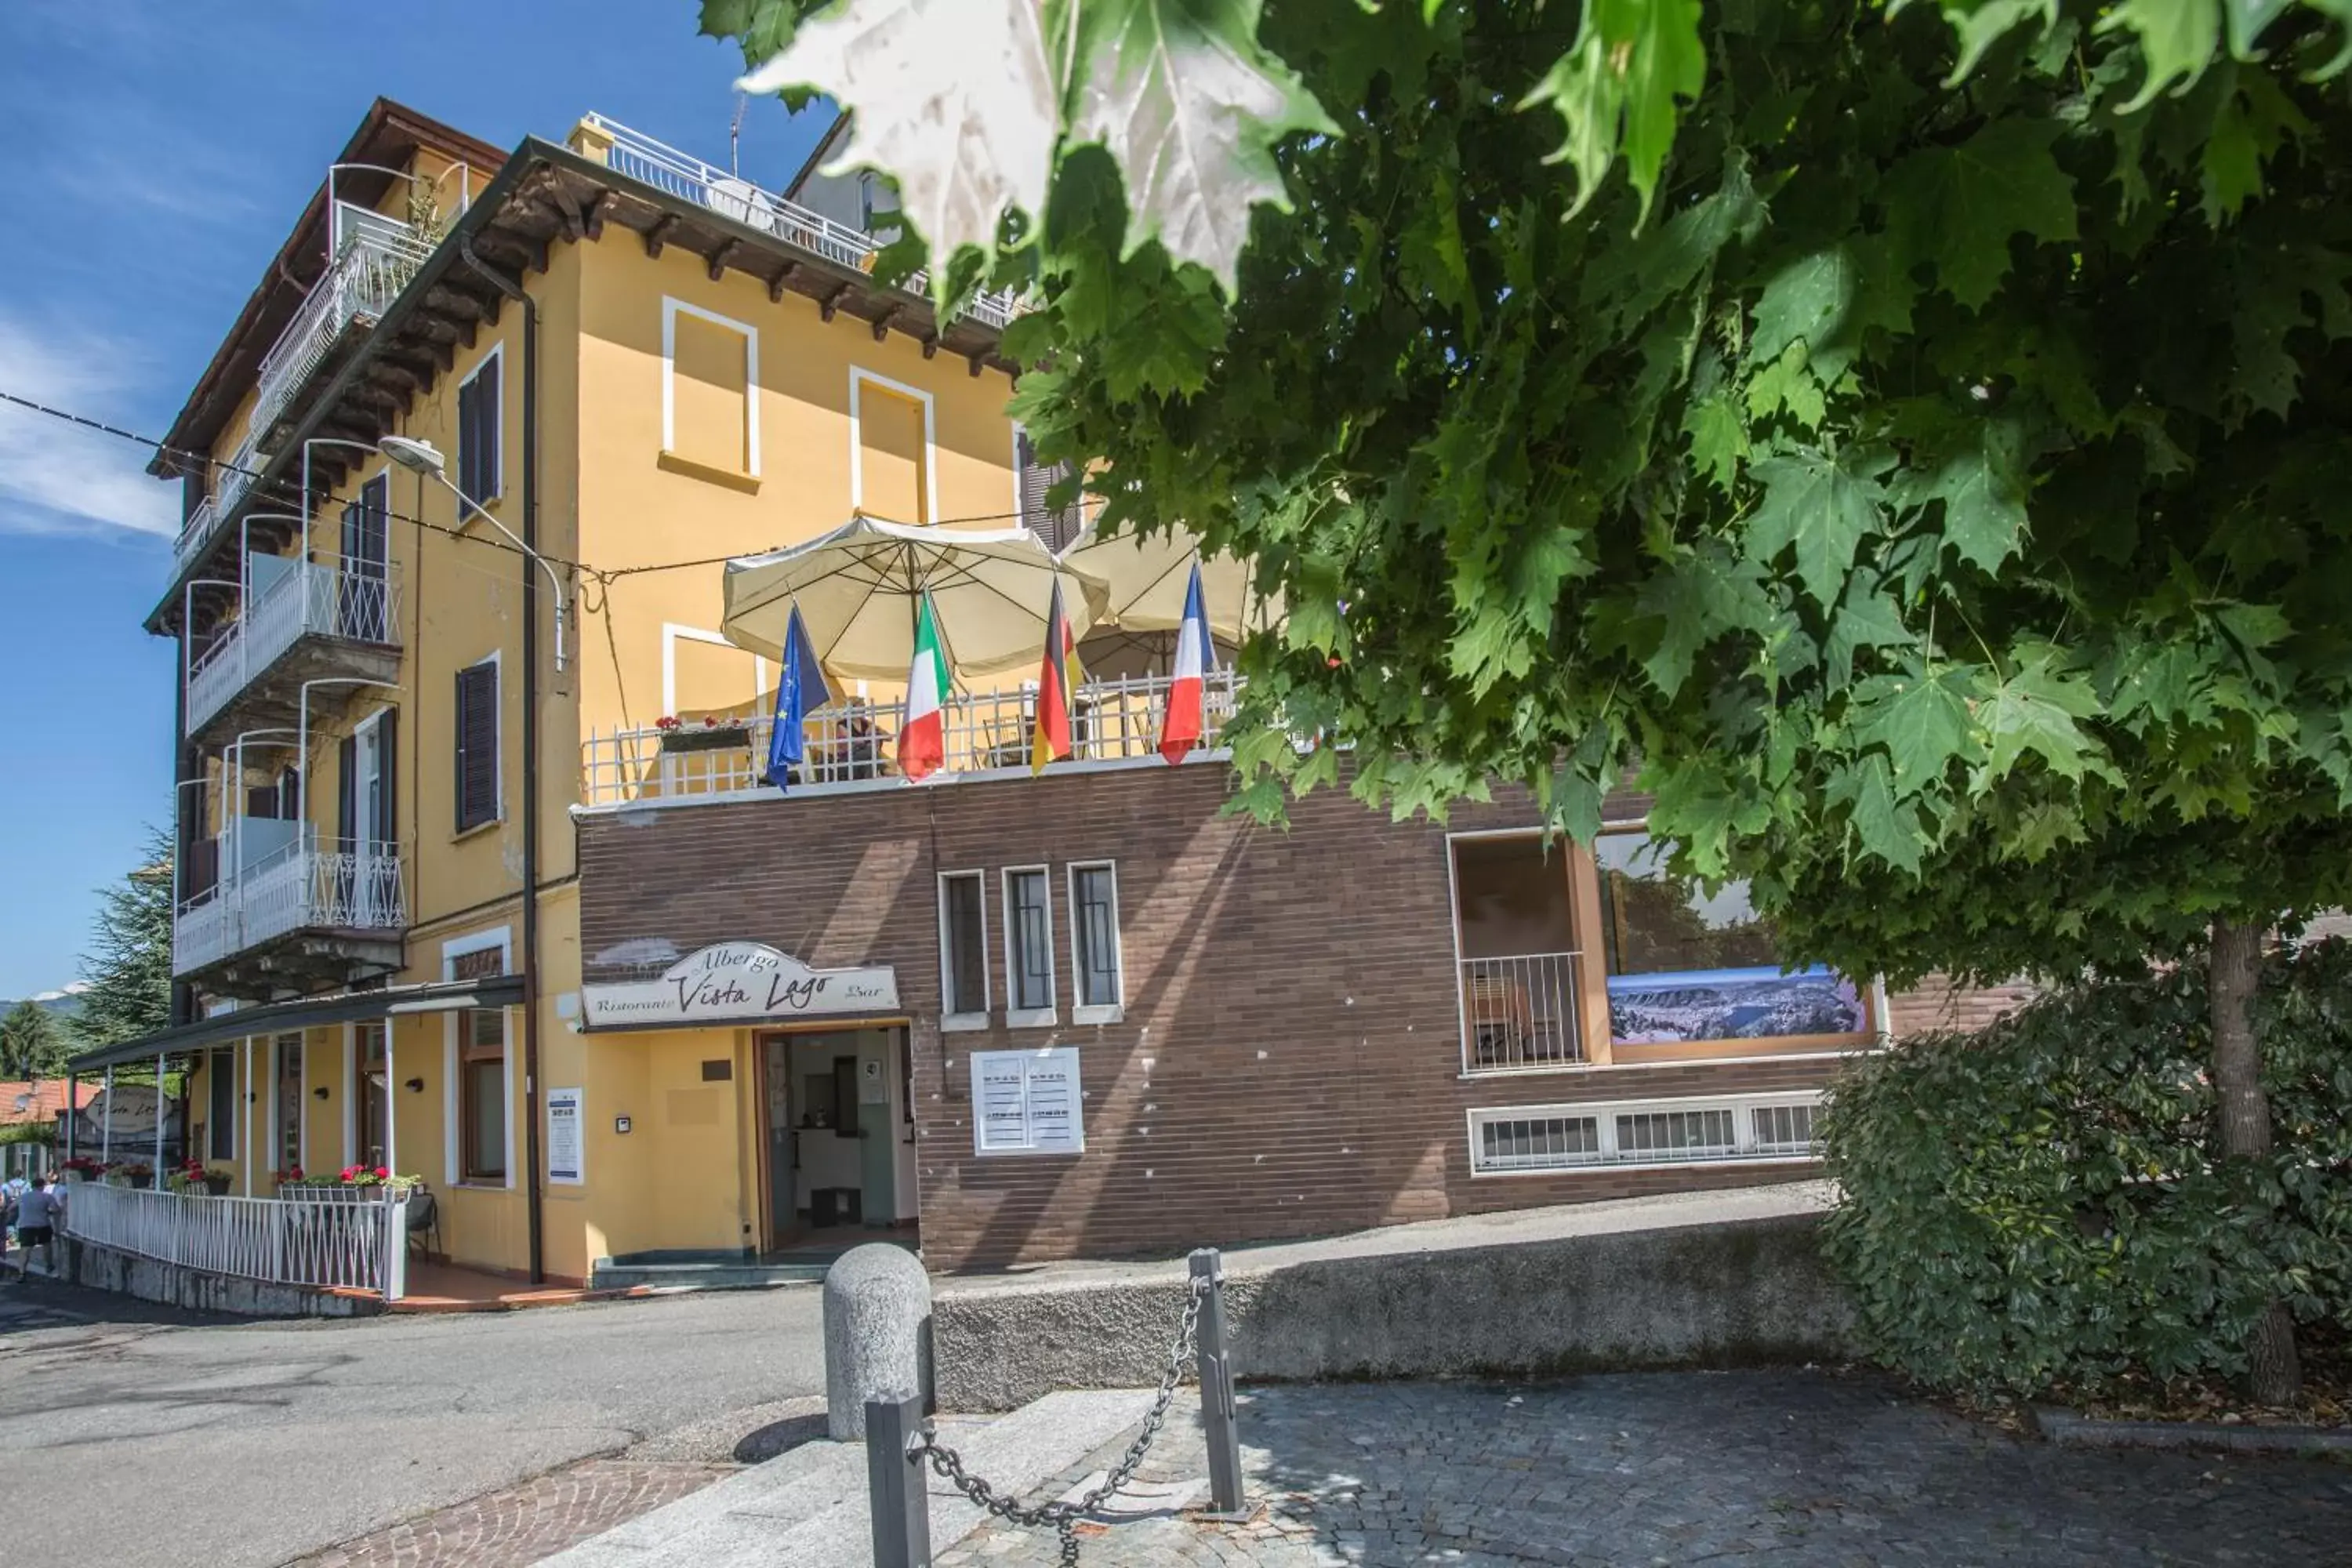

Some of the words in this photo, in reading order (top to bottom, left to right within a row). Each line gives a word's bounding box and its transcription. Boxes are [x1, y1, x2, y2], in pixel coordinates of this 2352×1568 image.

[691, 946, 779, 975] Albergo
[667, 971, 751, 1013] Vista
[764, 973, 834, 1011] Lago
[844, 985, 884, 999] Bar
[596, 998, 675, 1013] Ristorante
